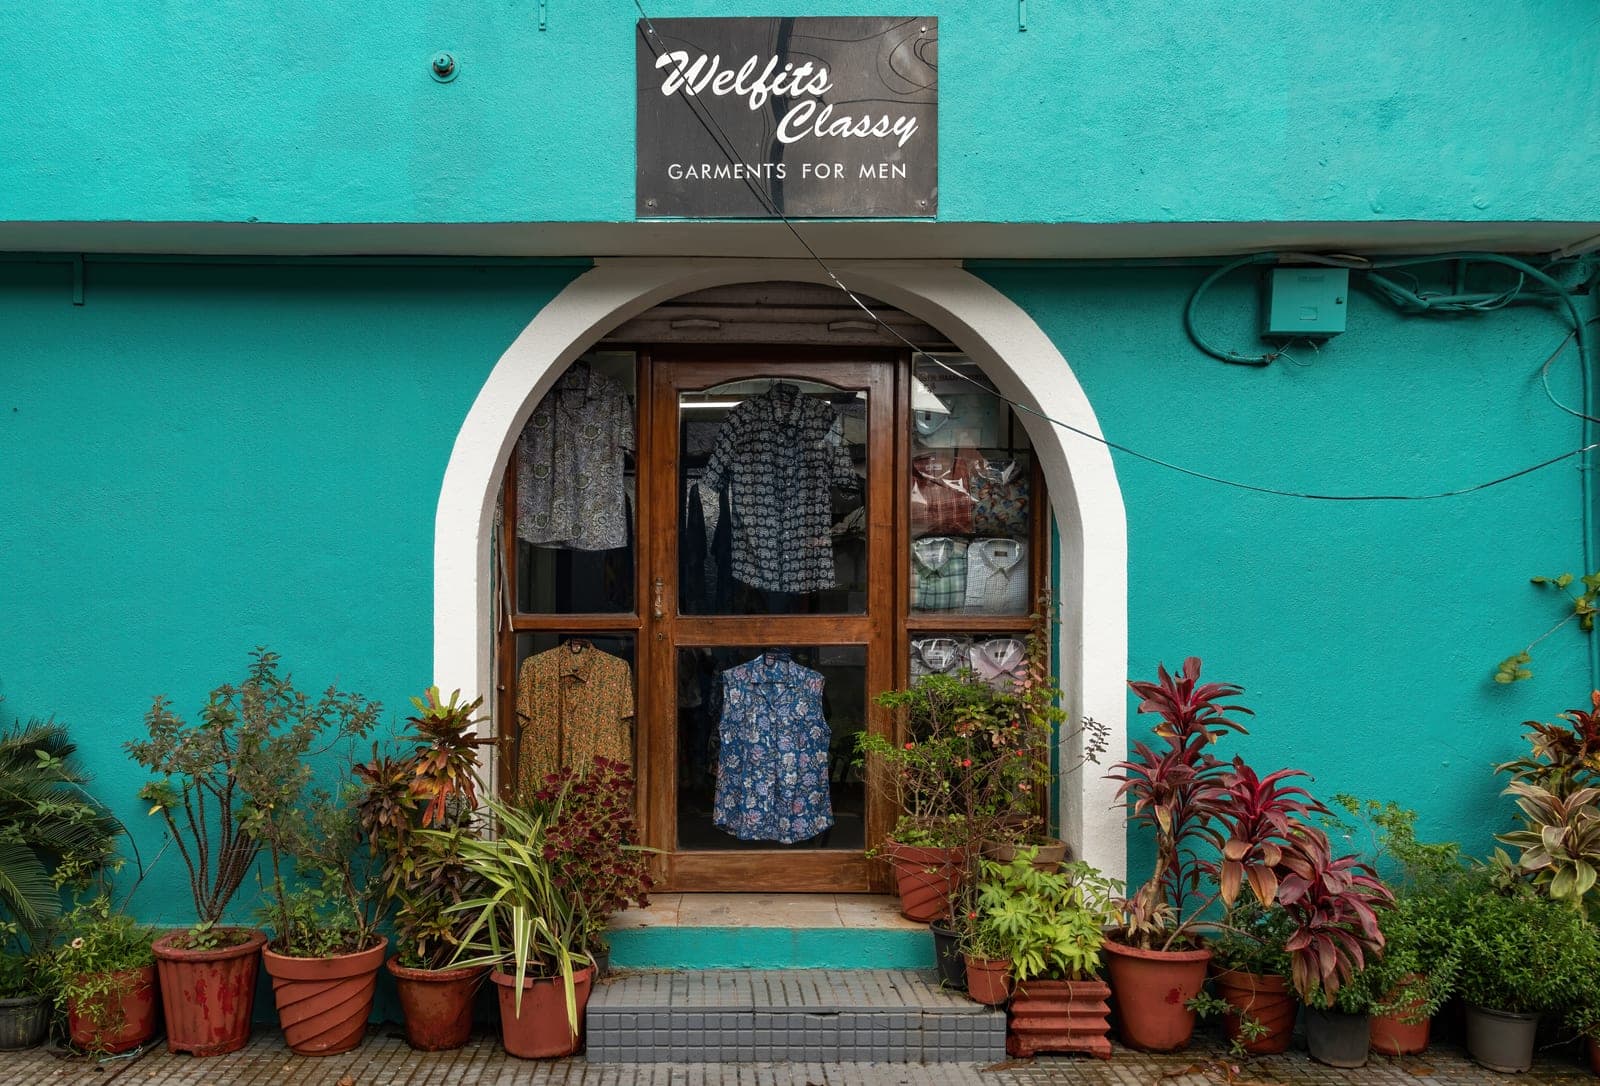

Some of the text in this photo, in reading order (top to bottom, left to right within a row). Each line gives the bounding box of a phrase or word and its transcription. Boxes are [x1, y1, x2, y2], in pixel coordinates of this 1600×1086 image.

[655, 50, 833, 110] Welfits
[776, 100, 919, 148] Classy
[667, 162, 907, 180] GARMENTS FOR MEN
